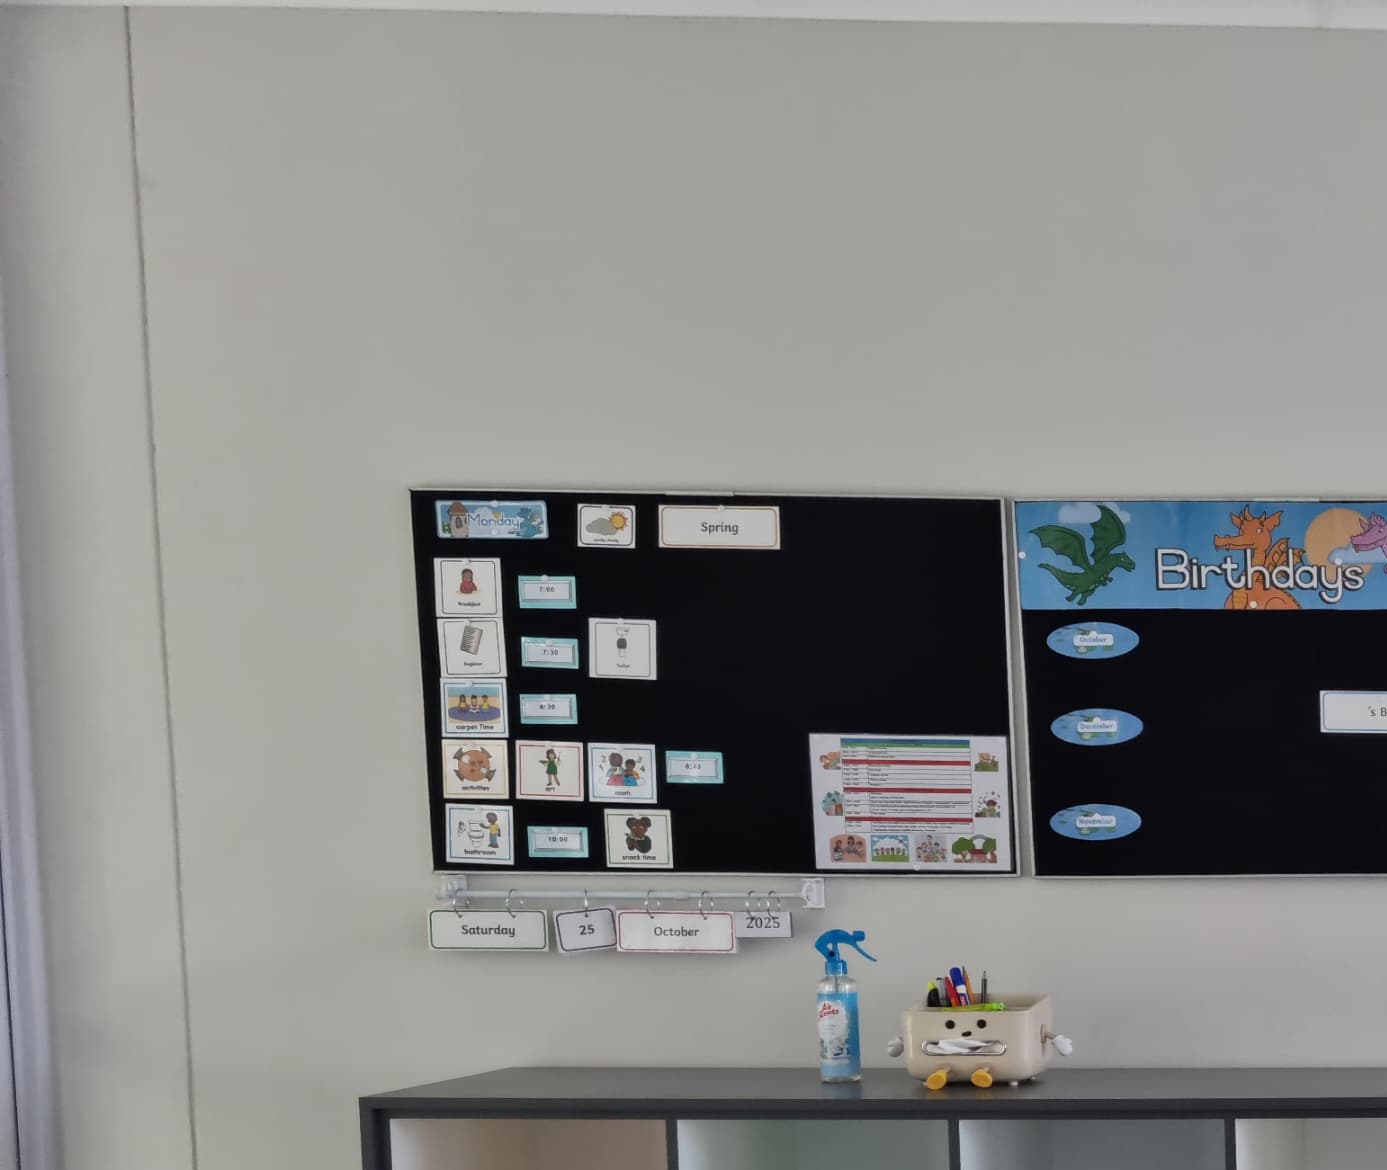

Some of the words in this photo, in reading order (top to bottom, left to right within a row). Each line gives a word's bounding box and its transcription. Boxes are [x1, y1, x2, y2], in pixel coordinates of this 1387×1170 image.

[467, 514, 520, 530] Monday
[701, 522, 739, 535] Spring
[1156, 548, 1365, 604] Birthdays
[464, 848, 497, 856] bathroom
[746, 916, 781, 929] 2025
[461, 924, 516, 938] Saturday
[579, 924, 595, 936] 25
[653, 925, 700, 937] October
